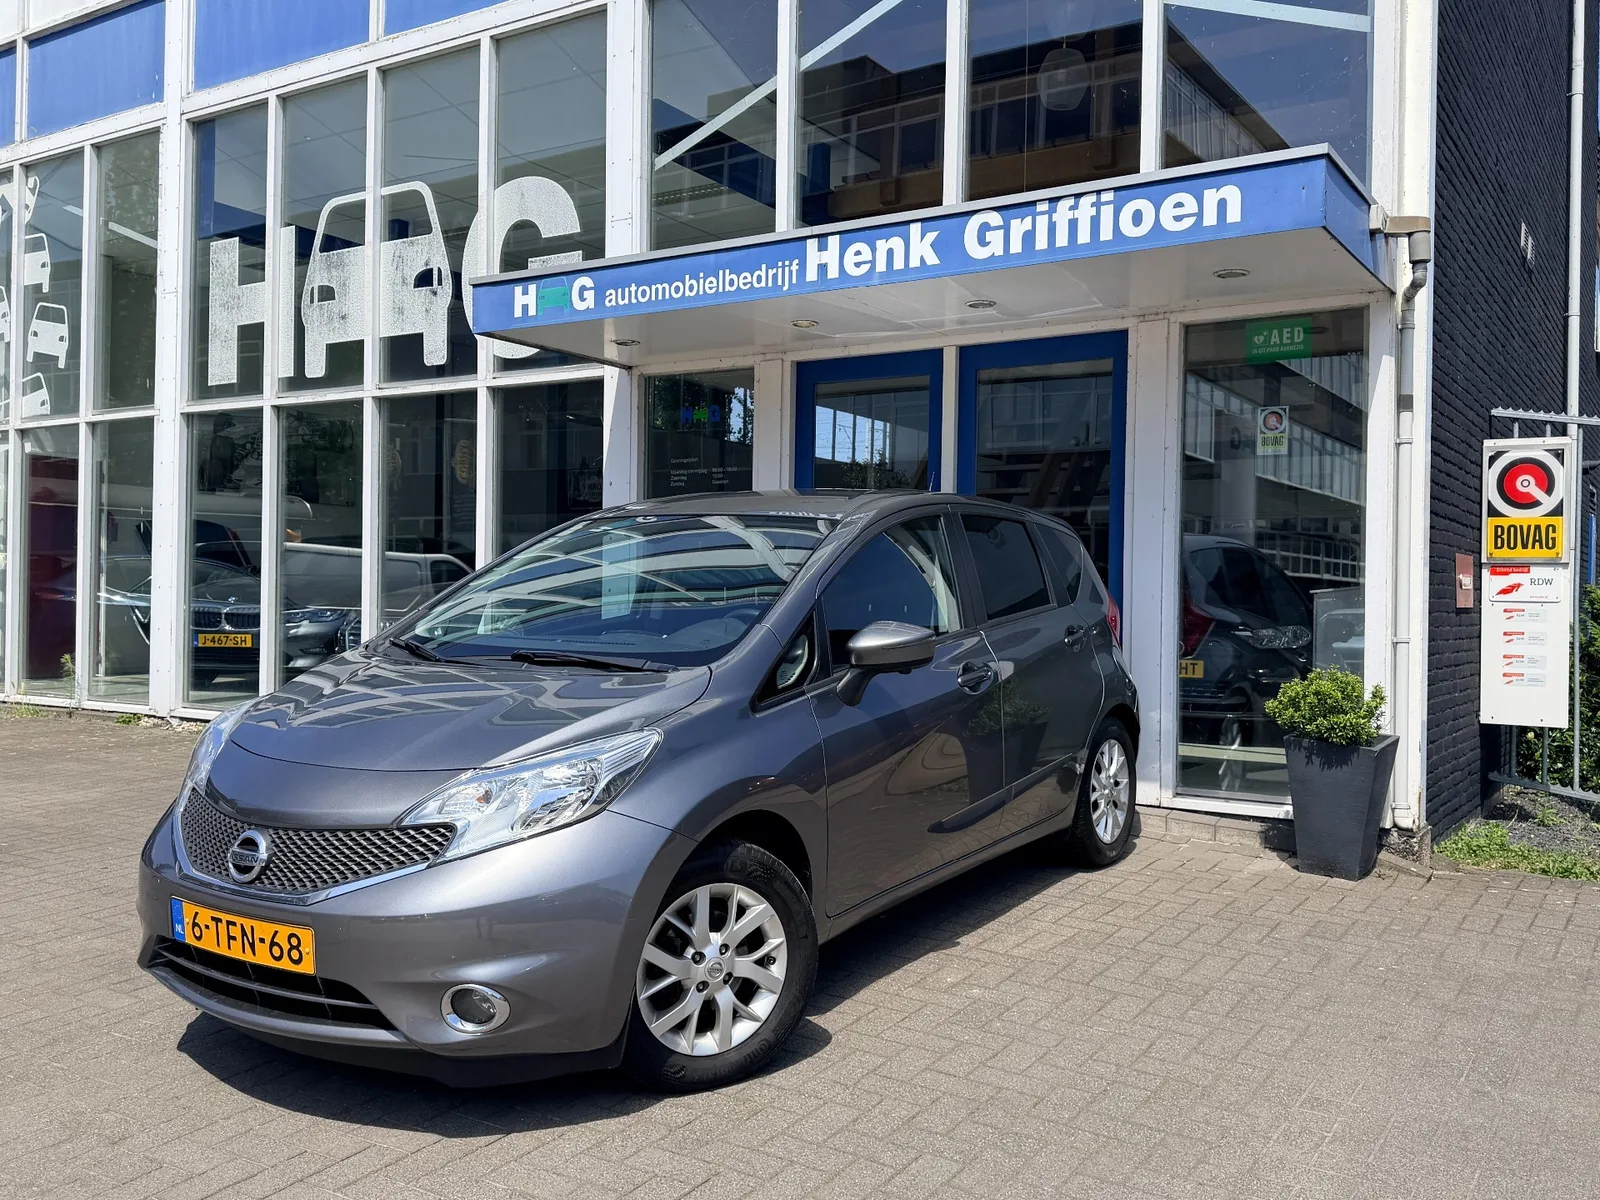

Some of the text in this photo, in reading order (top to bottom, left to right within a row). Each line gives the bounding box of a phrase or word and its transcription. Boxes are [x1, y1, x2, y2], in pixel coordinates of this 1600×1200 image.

[605, 258, 799, 308] automobielbedrijf
[804, 221, 941, 282] Henk
[963, 183, 1242, 258] Griffioen
[1270, 327, 1304, 345] AED
[1279, 344, 1304, 352] AANWEZIG
[1261, 436, 1284, 447] BOVAG
[1493, 523, 1557, 551] BOVAG
[1529, 577, 1554, 586] RDW
[201, 635, 247, 646] J-467-SH
[175, 923, 185, 935] NL
[191, 911, 304, 965] 6-TFN-68
